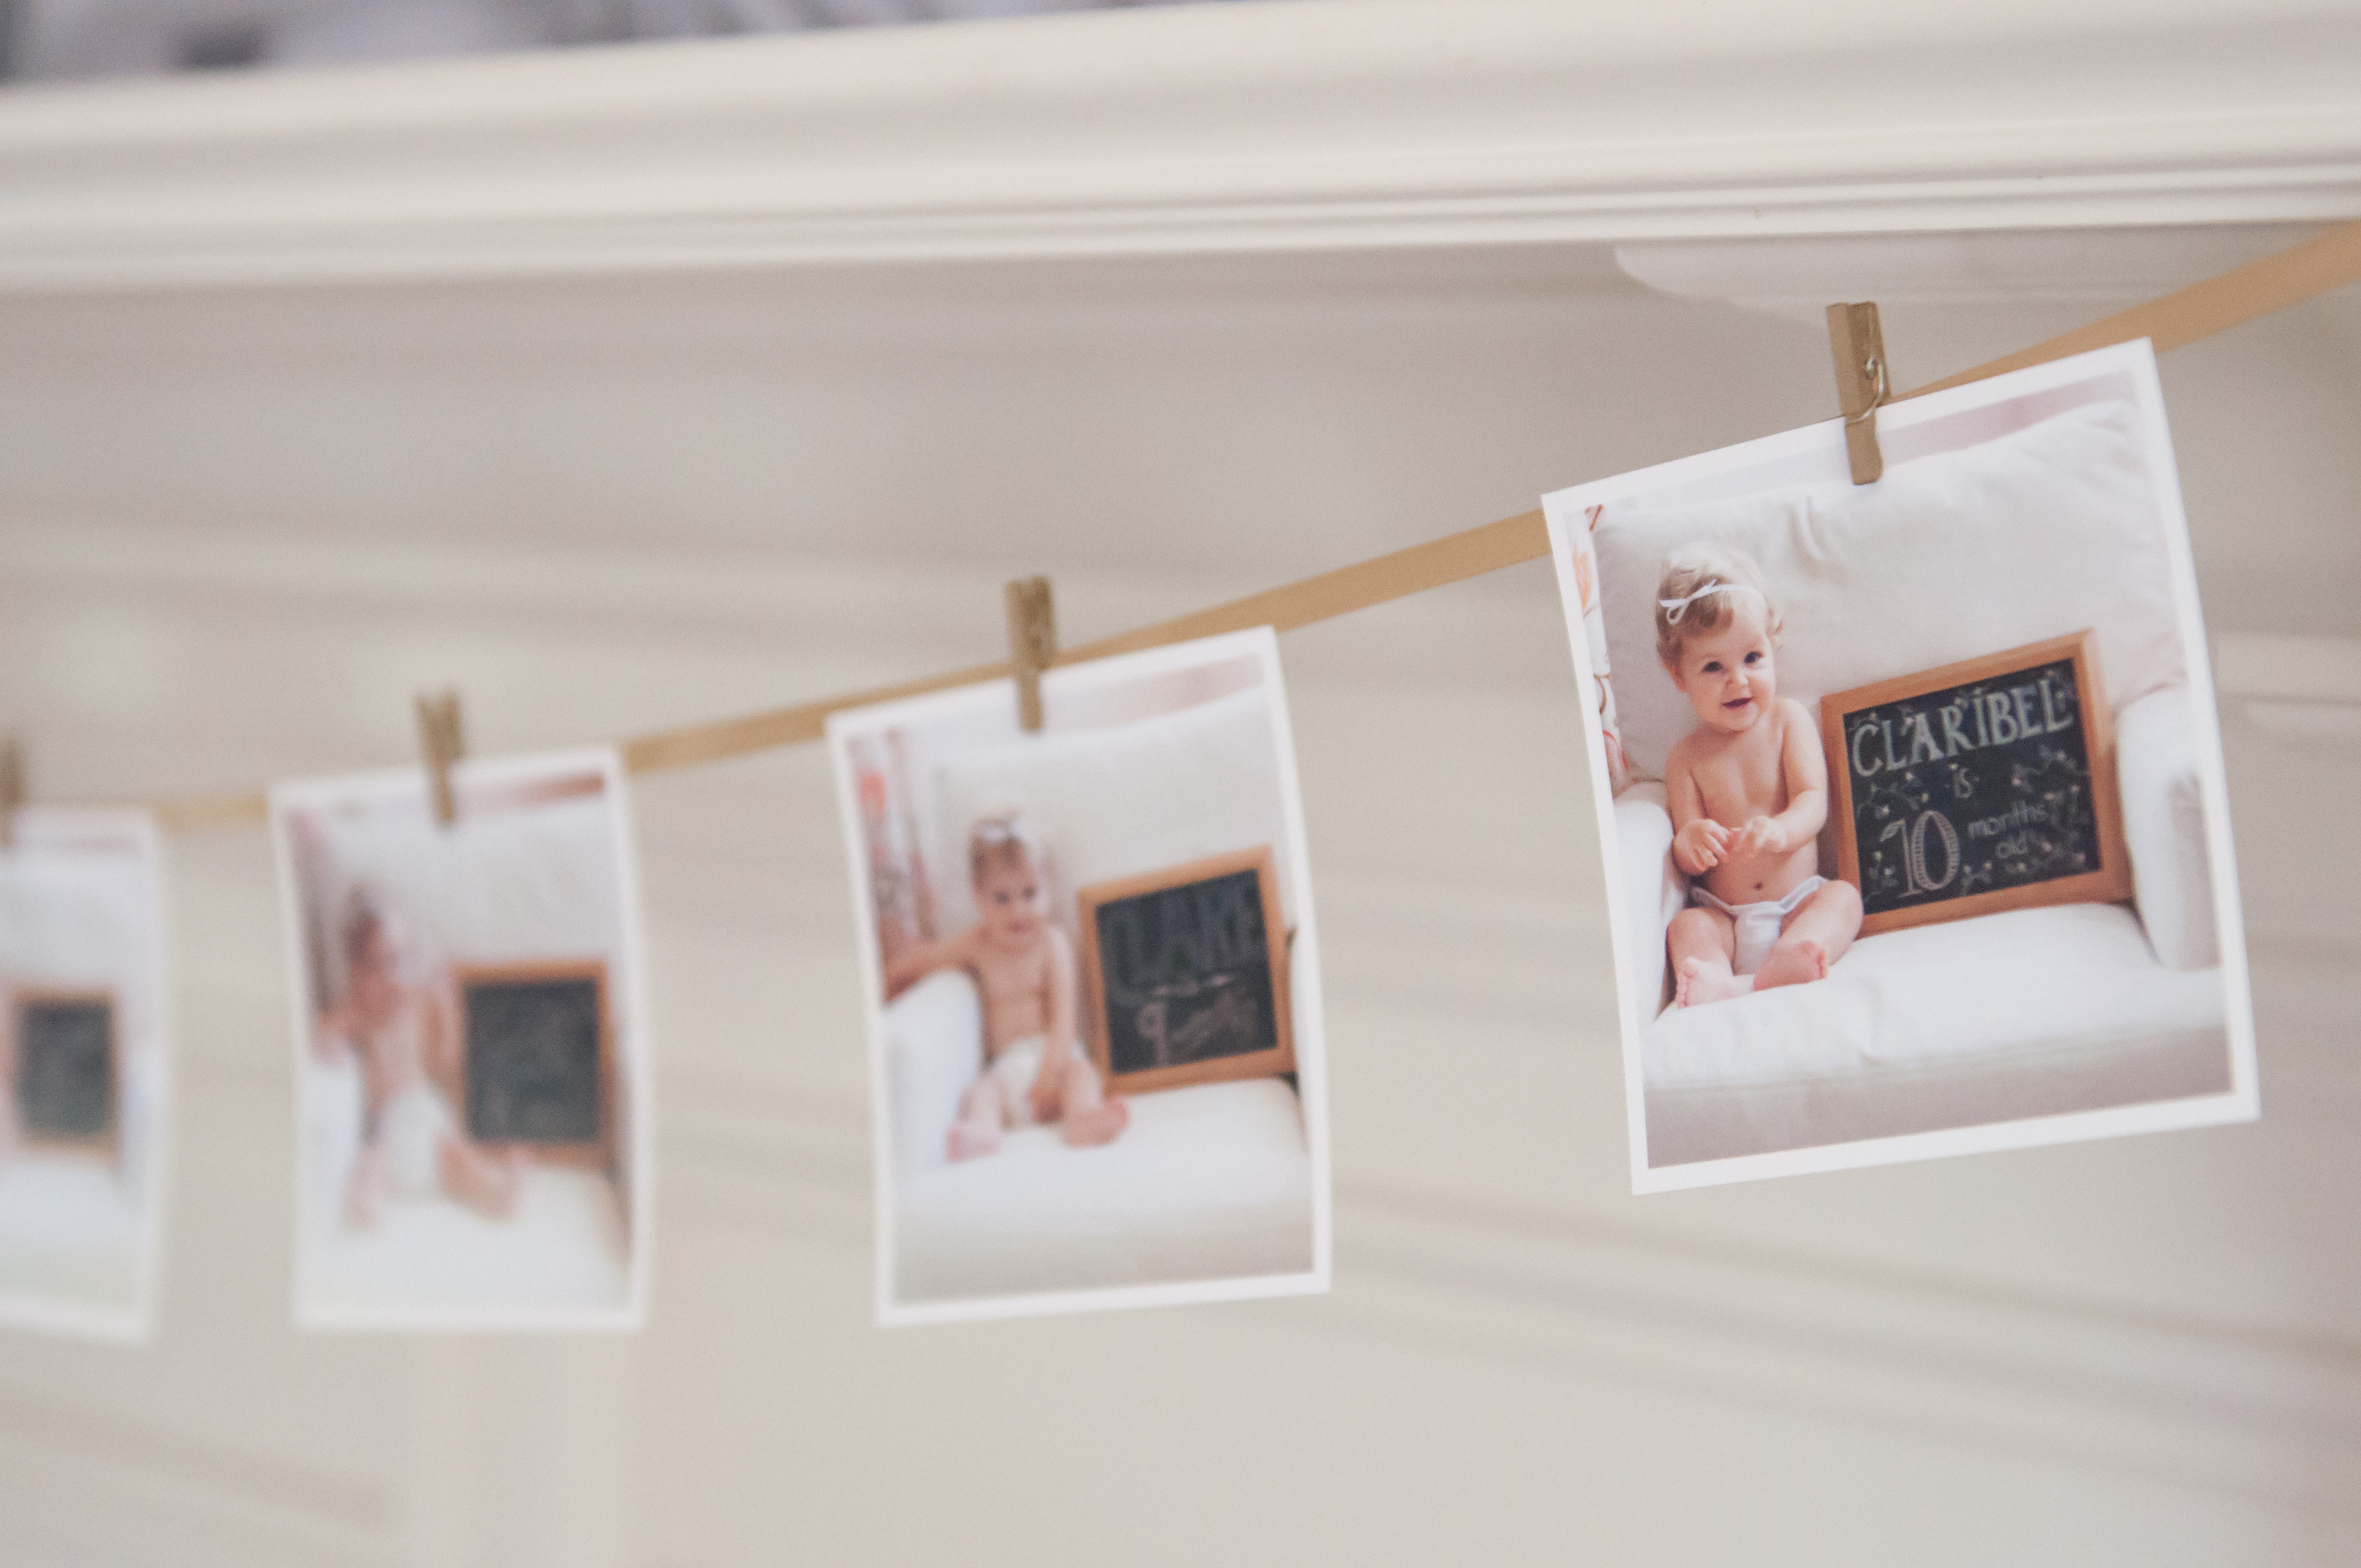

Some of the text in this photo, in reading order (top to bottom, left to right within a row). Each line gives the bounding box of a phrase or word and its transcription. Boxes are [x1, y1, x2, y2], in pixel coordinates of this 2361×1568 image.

[1853, 679, 2074, 776] CLARIBEL
[1952, 769, 1973, 798] is
[1880, 800, 2049, 897] 10 months
[1995, 830, 2028, 859] old
